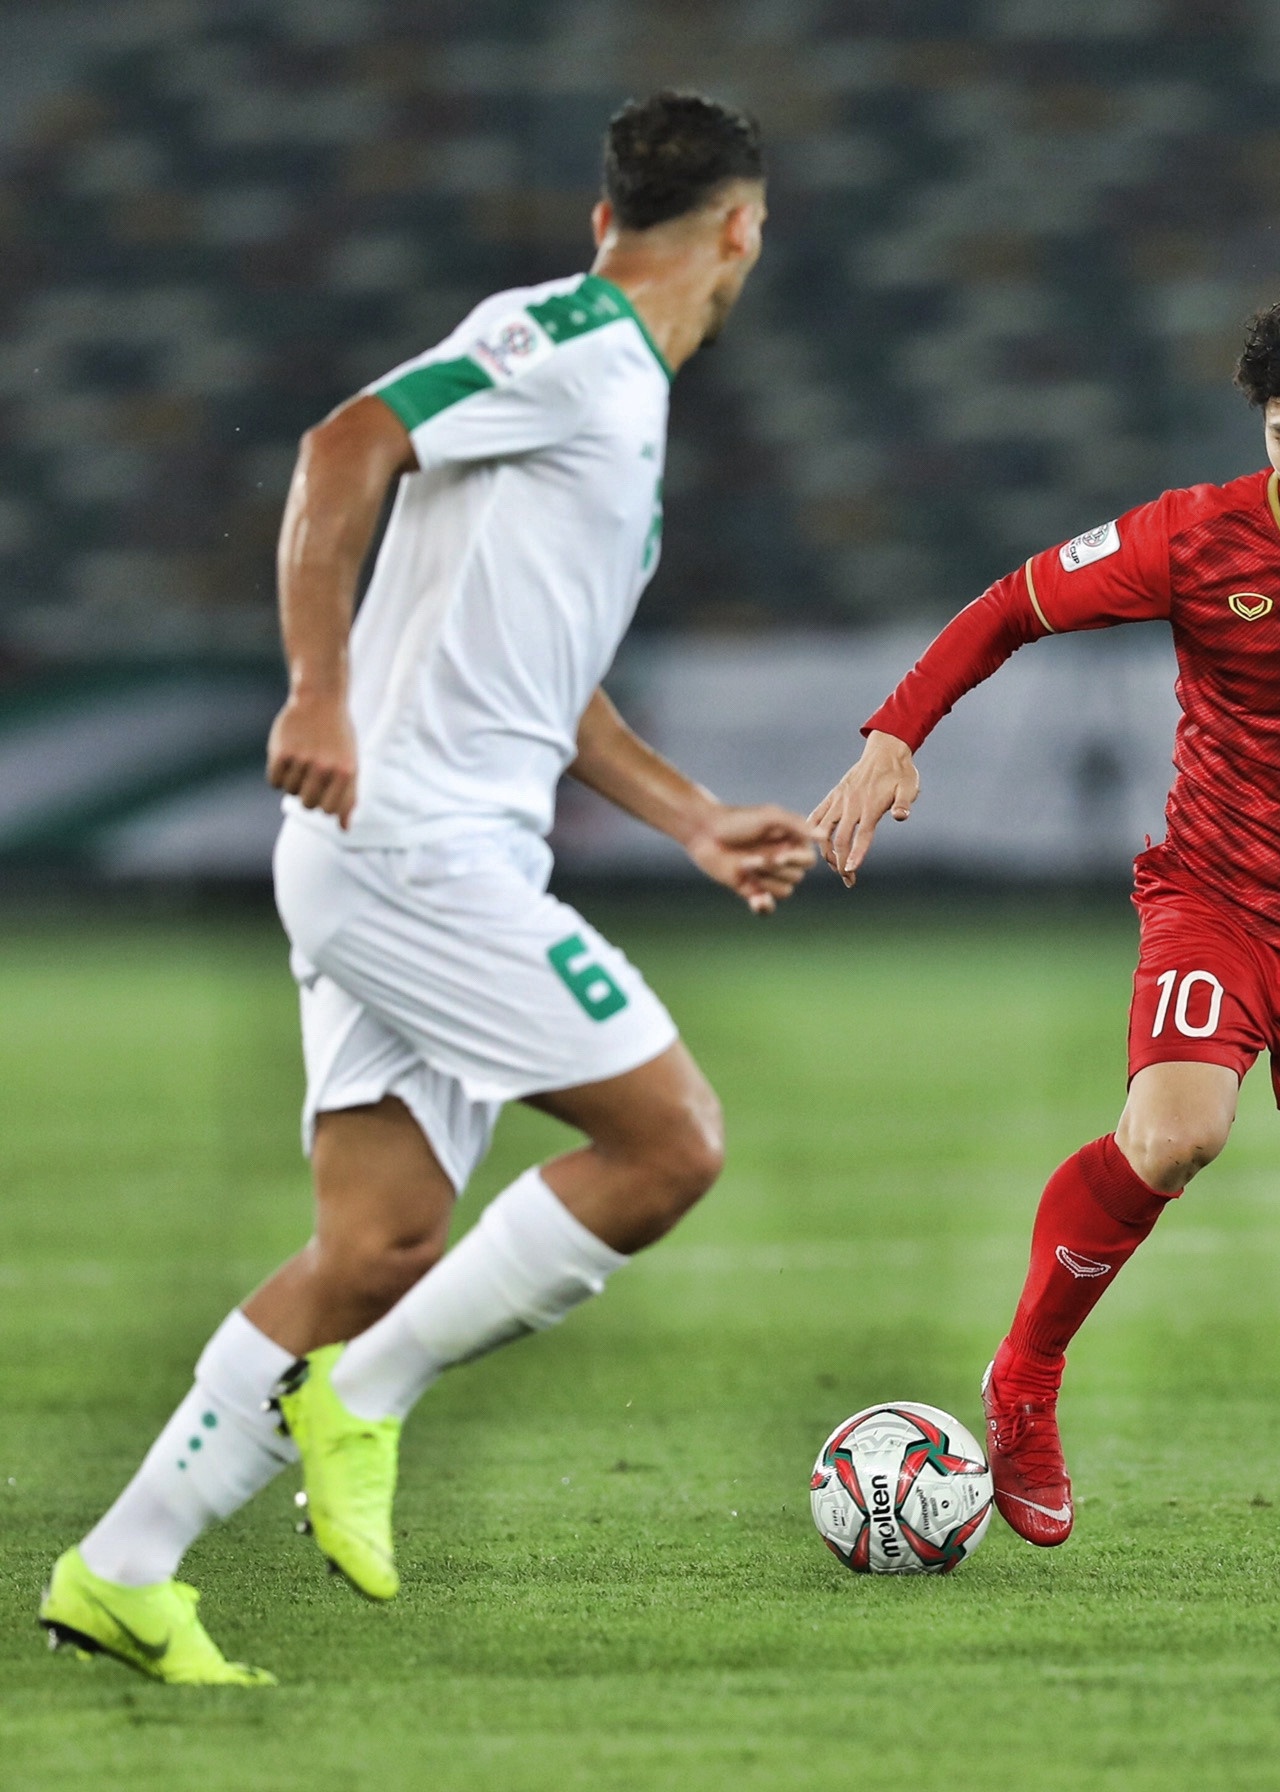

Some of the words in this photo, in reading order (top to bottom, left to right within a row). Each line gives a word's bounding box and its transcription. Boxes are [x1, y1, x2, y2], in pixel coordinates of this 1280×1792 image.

[1070, 546, 1080, 564] CUP
[547, 933, 629, 1022] 6
[1151, 969, 1224, 1038] 10
[871, 1474, 902, 1558] molten
